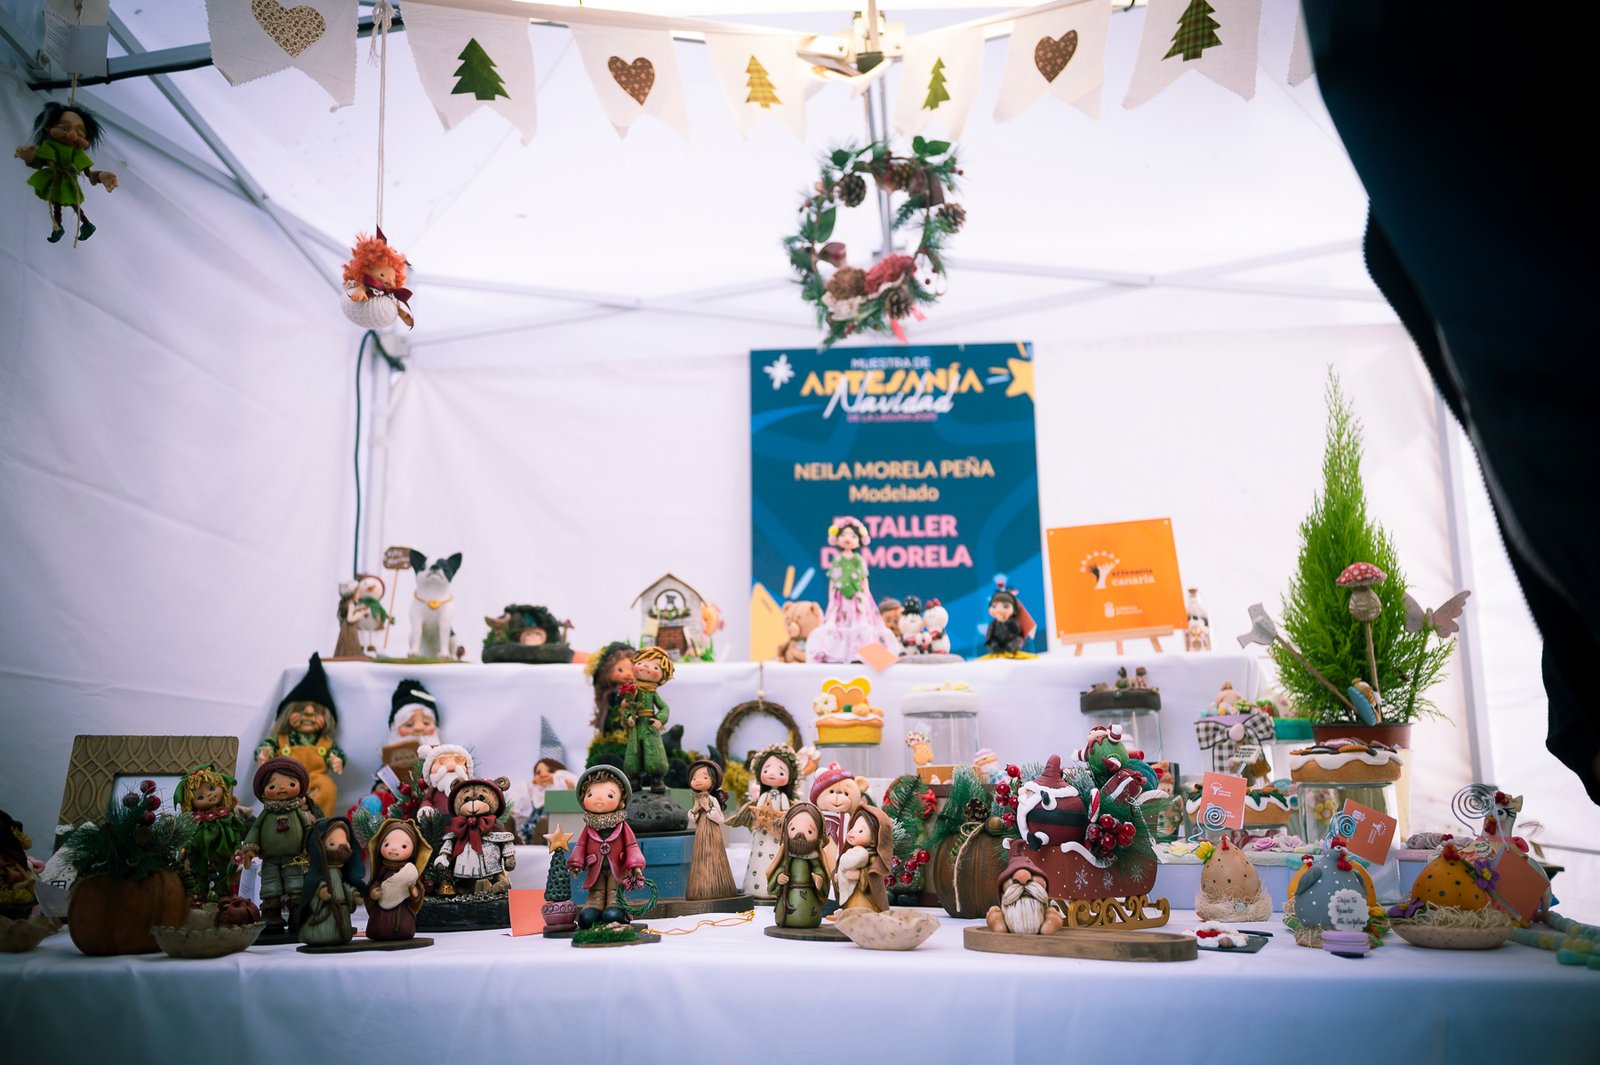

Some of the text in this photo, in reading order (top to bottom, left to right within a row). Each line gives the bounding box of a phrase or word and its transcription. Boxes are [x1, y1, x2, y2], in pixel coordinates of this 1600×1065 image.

[850, 355, 931, 370] MUESTRA DE
[800, 362, 984, 397] ARTESANÍA
[822, 371, 961, 419] Navidad
[794, 456, 995, 481] NEILA MORELA PEÑA
[848, 483, 940, 502] Modelado
[864, 514, 959, 538] TALLER
[861, 543, 973, 568] MORELA
[1111, 575, 1155, 587] canaria
